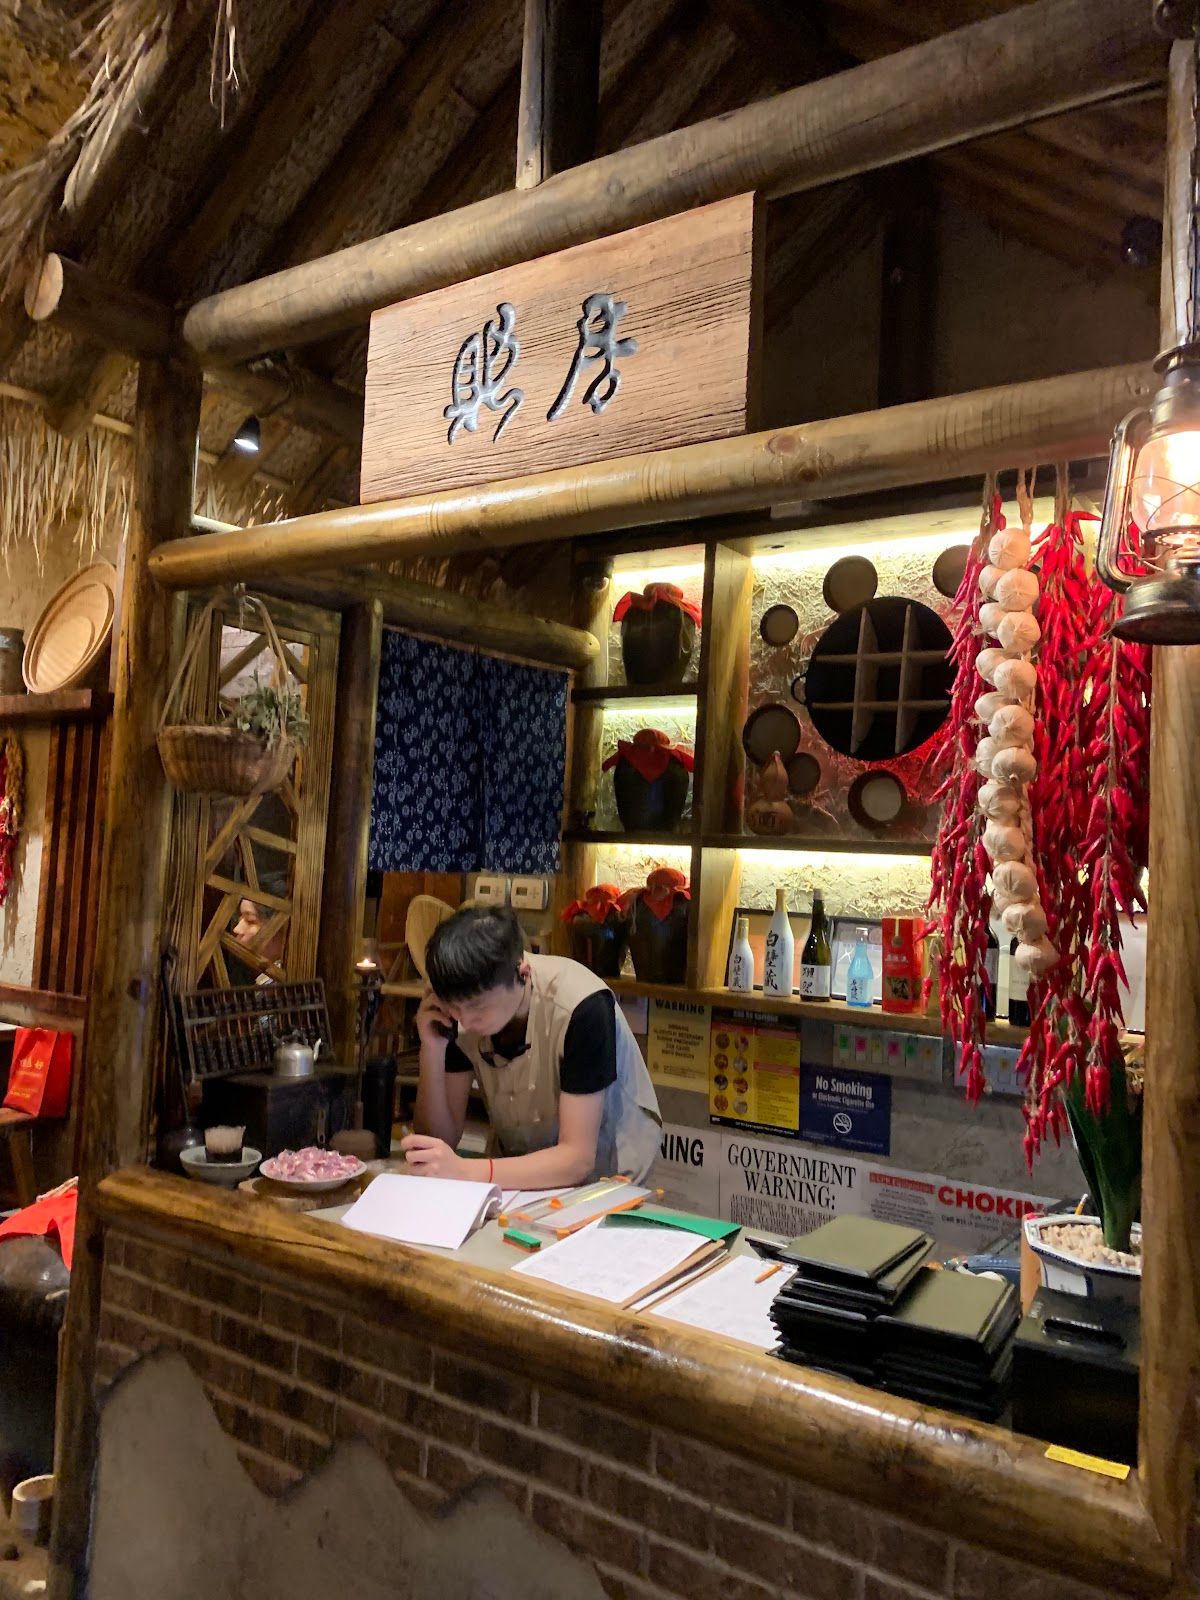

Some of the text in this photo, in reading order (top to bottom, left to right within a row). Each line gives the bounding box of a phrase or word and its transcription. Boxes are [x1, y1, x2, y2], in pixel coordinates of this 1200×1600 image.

[655, 998, 705, 1016] WARNING
[815, 1075, 873, 1100] No Smoking
[727, 1143, 857, 1189] GOVERNMENT
[744, 1170, 836, 1211] WARNING:
